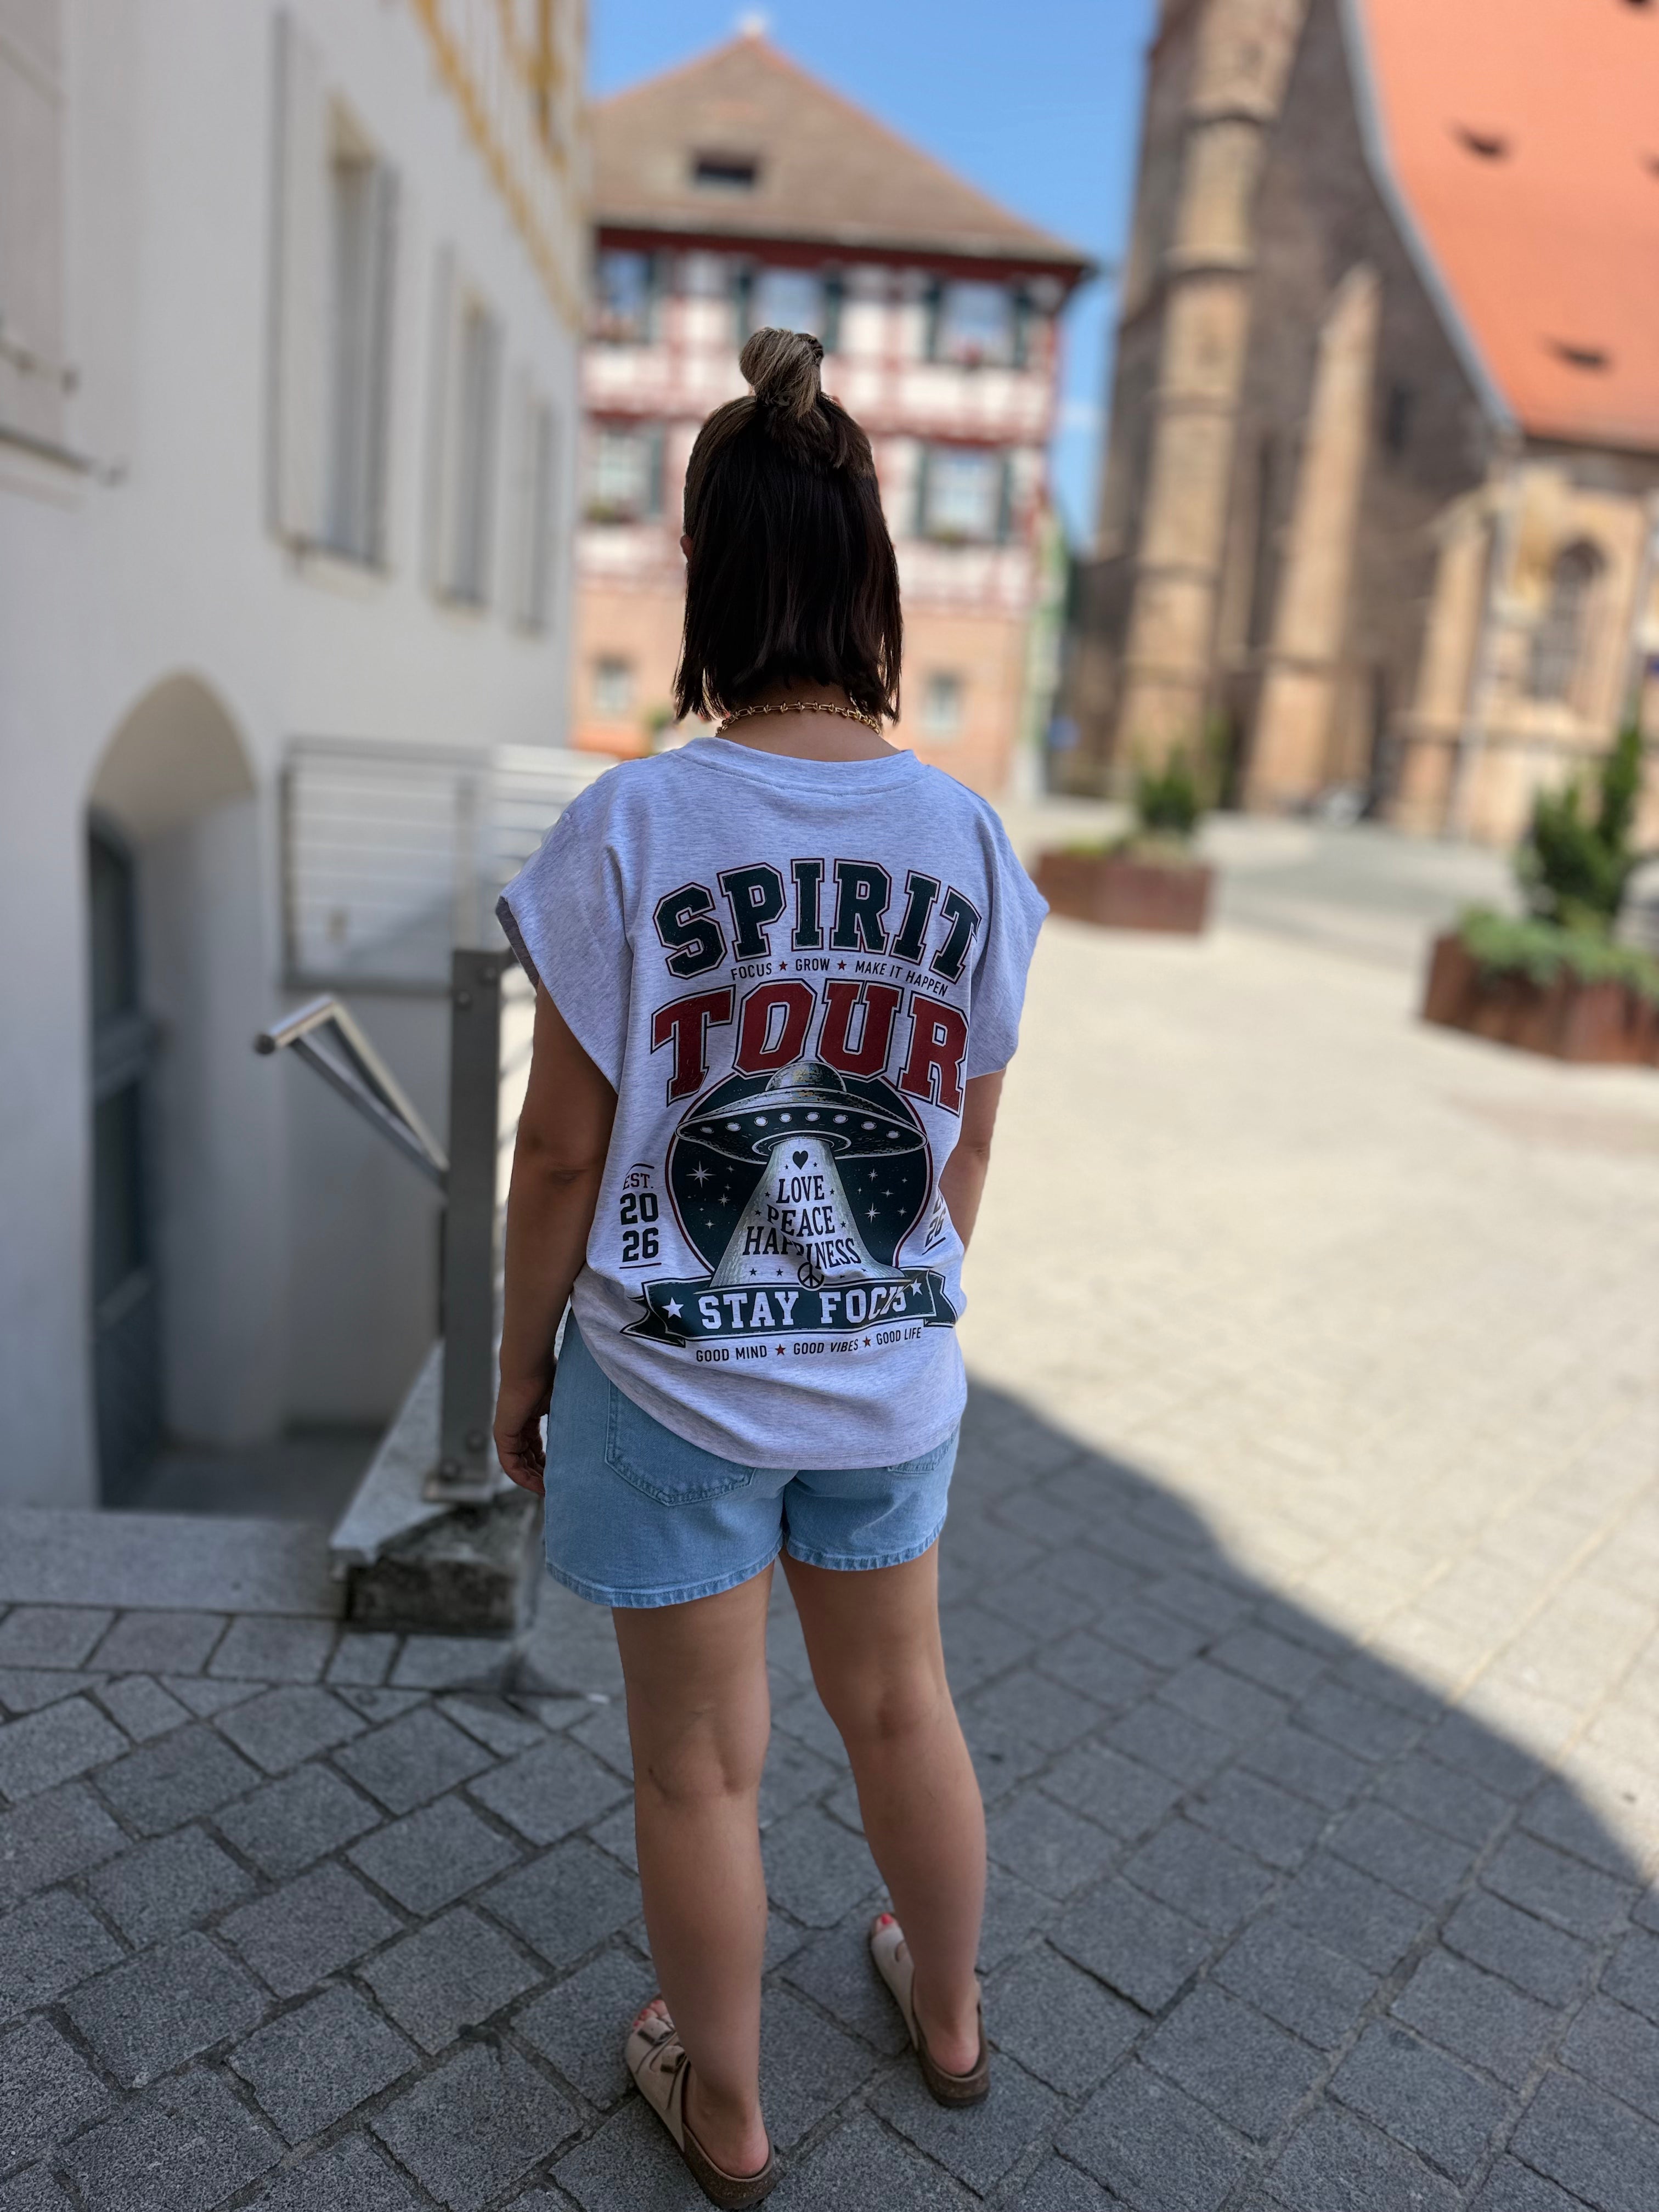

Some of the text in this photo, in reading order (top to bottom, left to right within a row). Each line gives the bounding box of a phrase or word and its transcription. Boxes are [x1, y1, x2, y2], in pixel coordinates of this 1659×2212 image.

[652, 857, 982, 985] SPIRIT
[730, 958, 949, 997] FOCUS GROW MAKE IT HAPPEN
[650, 978, 970, 1118] TOUR
[623, 1172, 653, 1190] EST.
[776, 1175, 825, 1204] LOVE
[620, 1193, 659, 1225] 20
[767, 1204, 835, 1237] PEACE
[622, 1227, 659, 1262] 26
[698, 1291, 801, 1330] STAY
[696, 1327, 922, 1362] GOOD MIND GOOD VIBES GOOD LIFE
